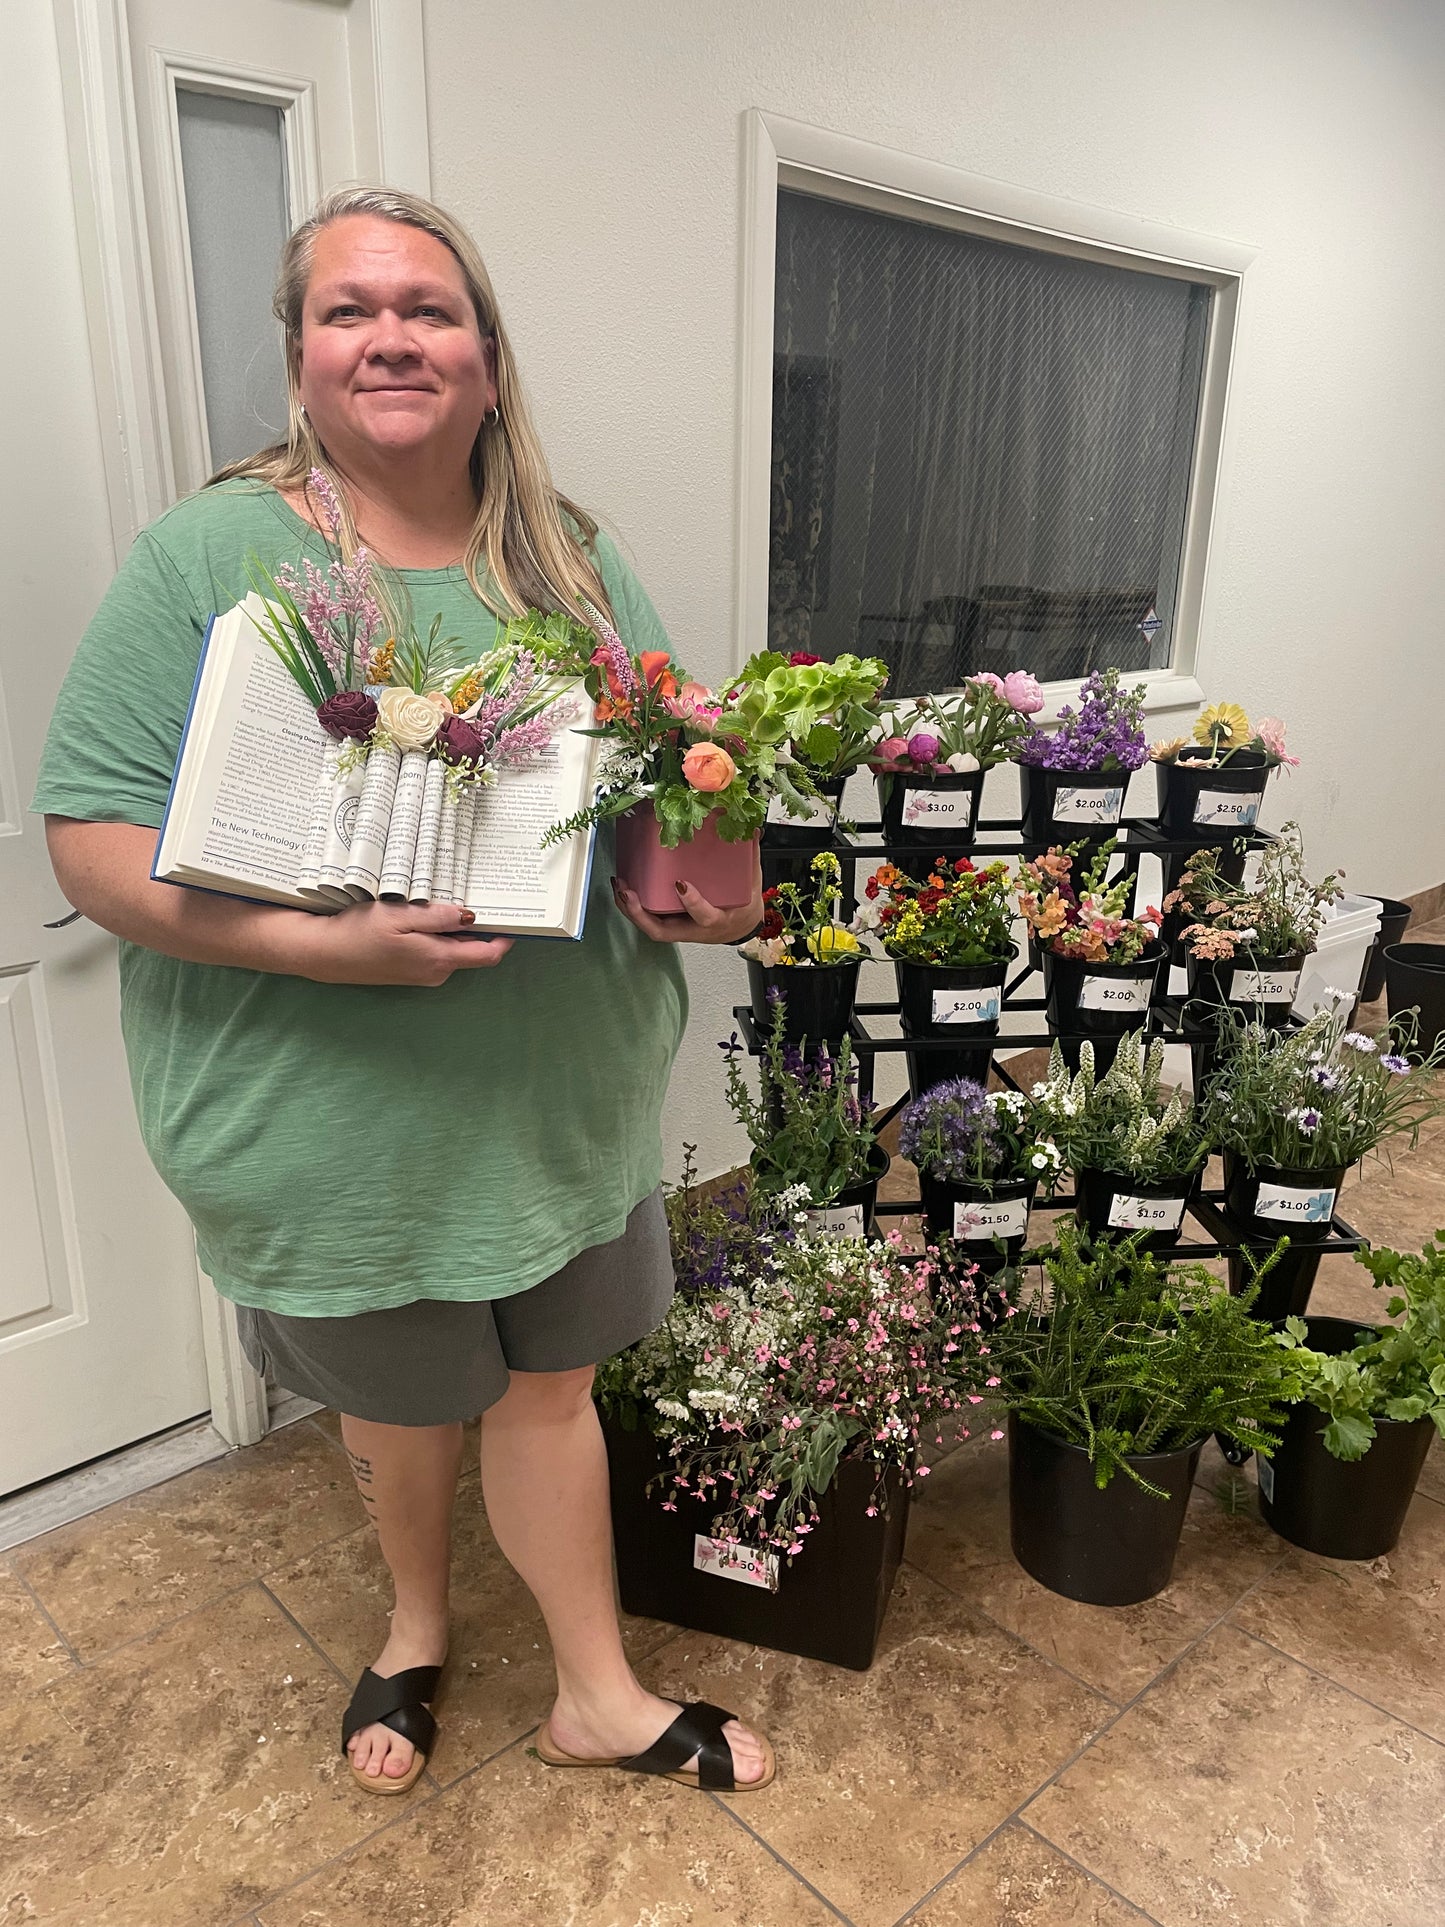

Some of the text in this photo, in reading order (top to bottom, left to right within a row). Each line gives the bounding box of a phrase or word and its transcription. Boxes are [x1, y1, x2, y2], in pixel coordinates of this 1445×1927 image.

[281, 727, 304, 740] Closing
[303, 735, 321, 745] Down
[400, 772, 422, 780] born
[927, 803, 954, 812] $3.00
[1075, 799, 1102, 808] $2.00
[1216, 804, 1243, 813] $2.50
[210, 816, 300, 851] The New Technology
[1256, 985, 1283, 994] $1.50
[1102, 990, 1131, 1001] $2.00
[953, 1001, 981, 1011] $2.00
[1137, 1208, 1165, 1218] $1.50
[1279, 1208, 1310, 1218] $1.00
[980, 1214, 1010, 1225] $1.50
[815, 1223, 846, 1233] $1.50
